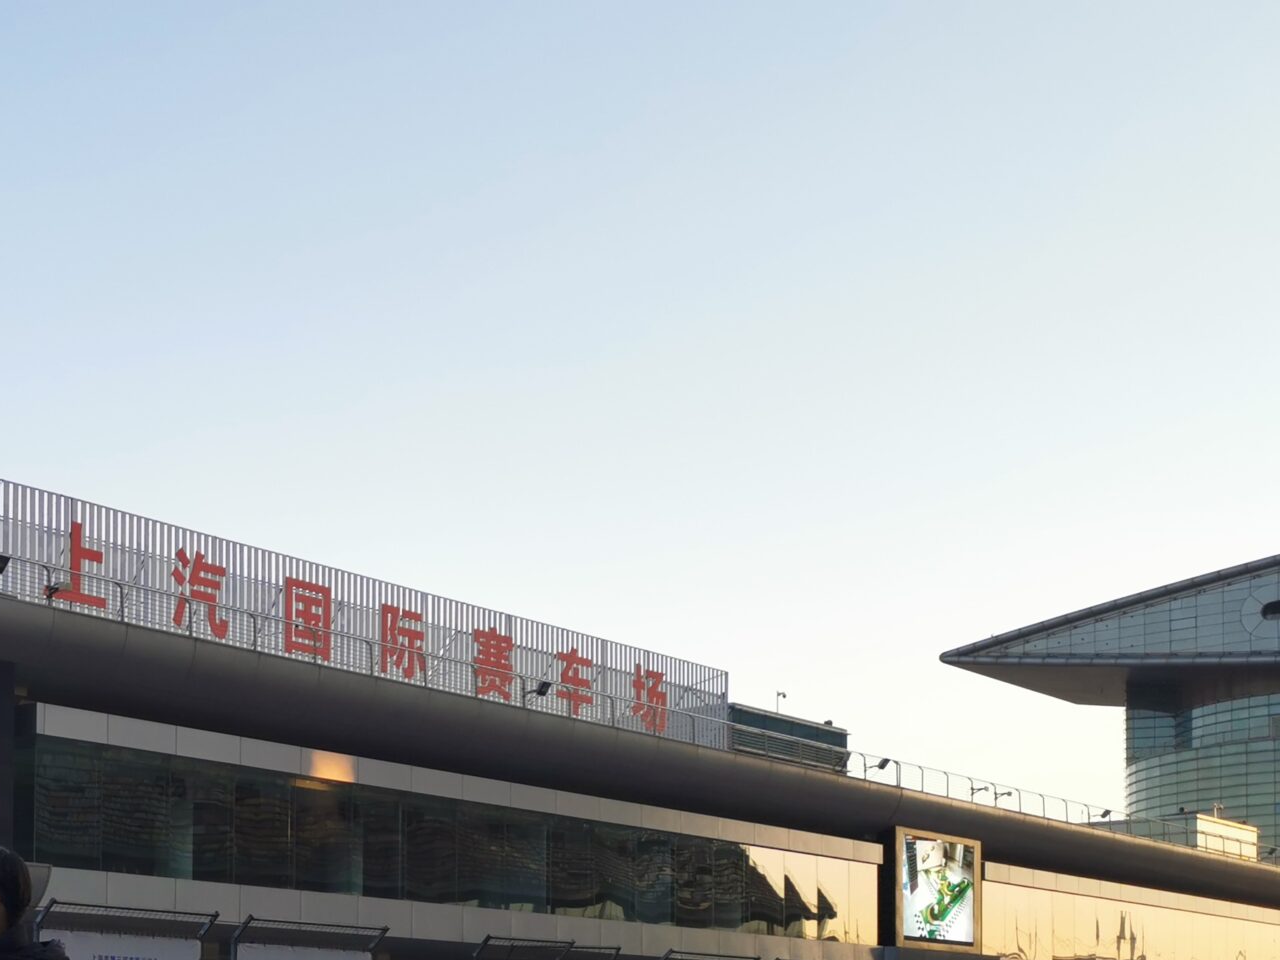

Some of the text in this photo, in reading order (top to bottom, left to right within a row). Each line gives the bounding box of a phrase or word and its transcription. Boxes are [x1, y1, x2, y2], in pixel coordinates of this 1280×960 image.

[44, 522, 667, 734] 上汽国际赛车场
